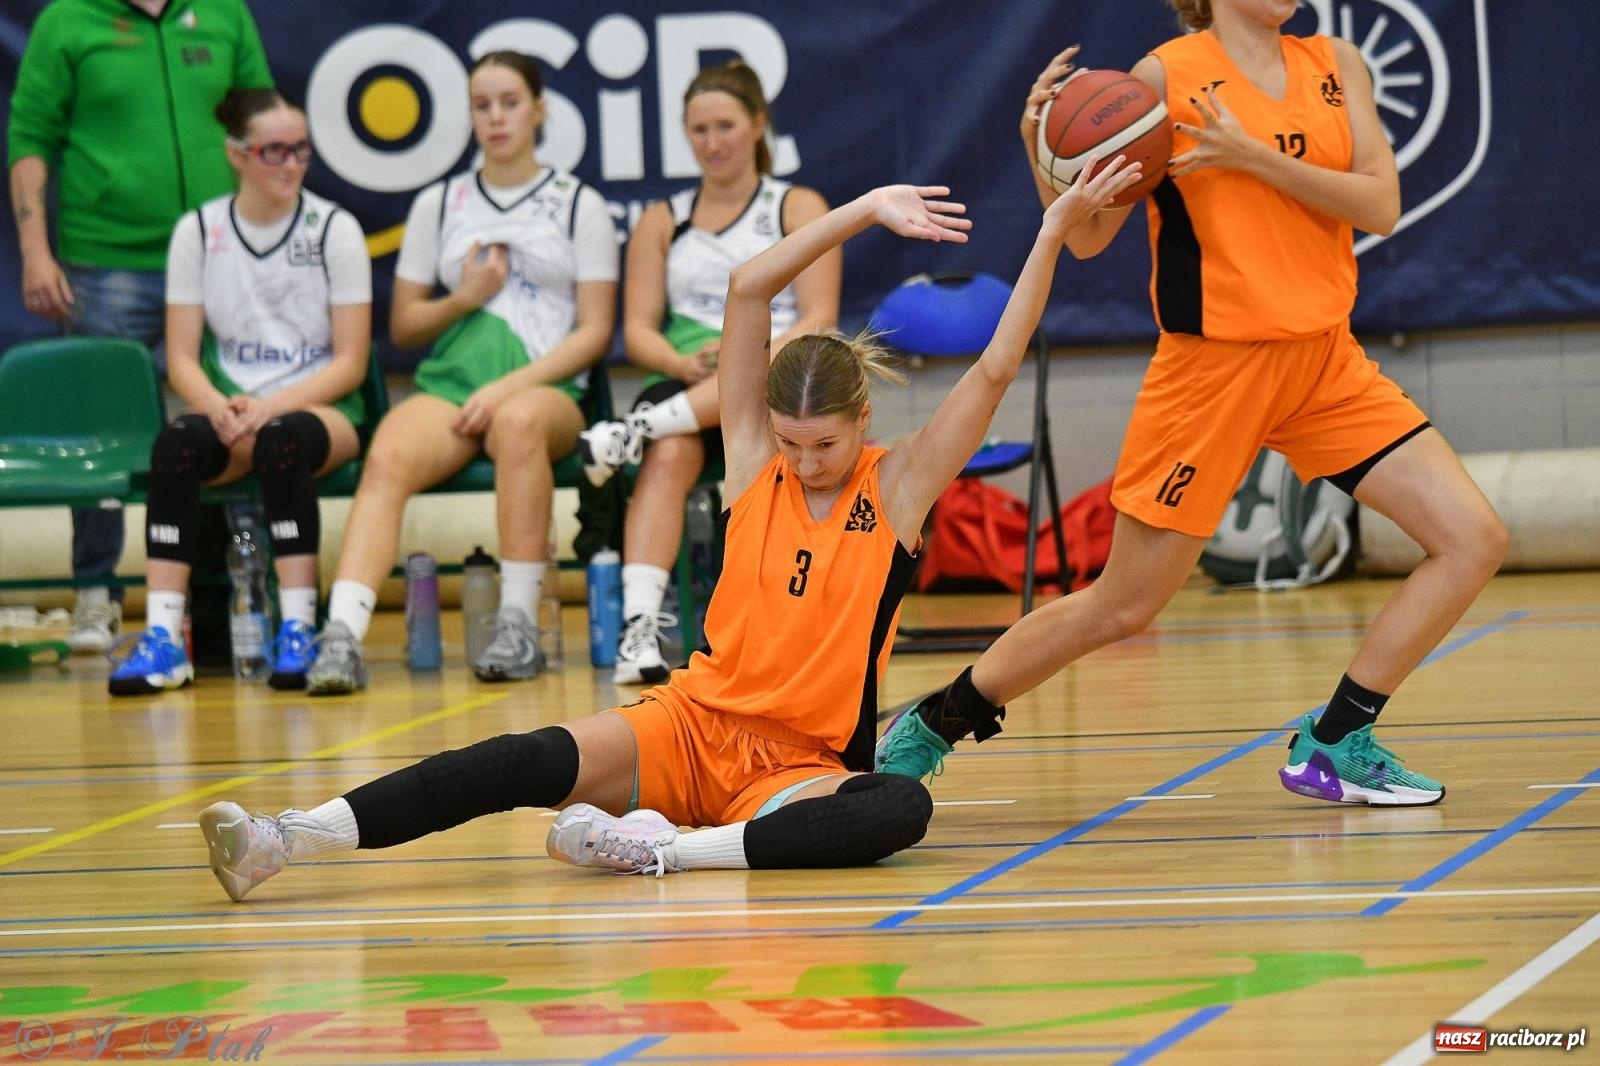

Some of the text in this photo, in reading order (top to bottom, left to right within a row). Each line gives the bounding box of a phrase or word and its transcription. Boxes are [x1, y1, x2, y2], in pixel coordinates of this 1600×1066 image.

[1274, 132, 1307, 159] 12
[1154, 461, 1196, 508] 12
[788, 549, 812, 597] 3
